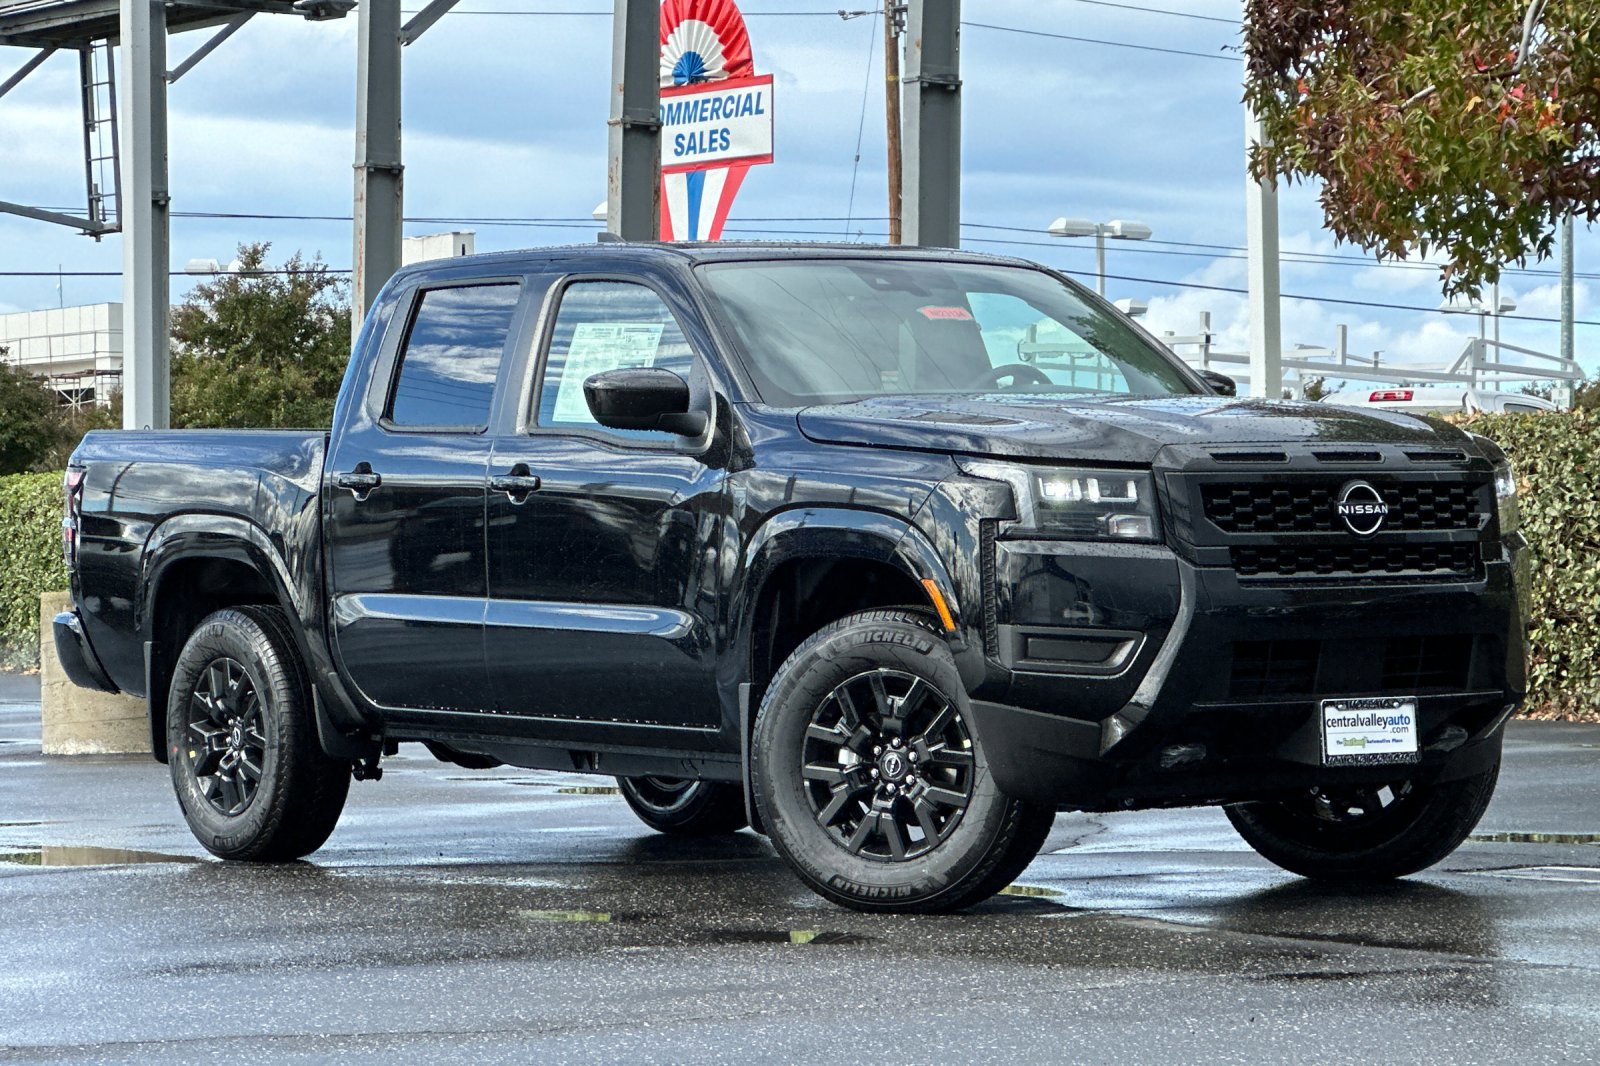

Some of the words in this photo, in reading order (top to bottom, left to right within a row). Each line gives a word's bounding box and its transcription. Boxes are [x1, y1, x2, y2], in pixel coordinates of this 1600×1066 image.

[674, 127, 731, 157] SALES
[1338, 504, 1389, 515] NISSAN
[852, 631, 933, 652] MICHELIN
[1326, 713, 1411, 730] centralvalleyauto
[1389, 726, 1409, 734] .com
[833, 877, 912, 898] MICHELIN
